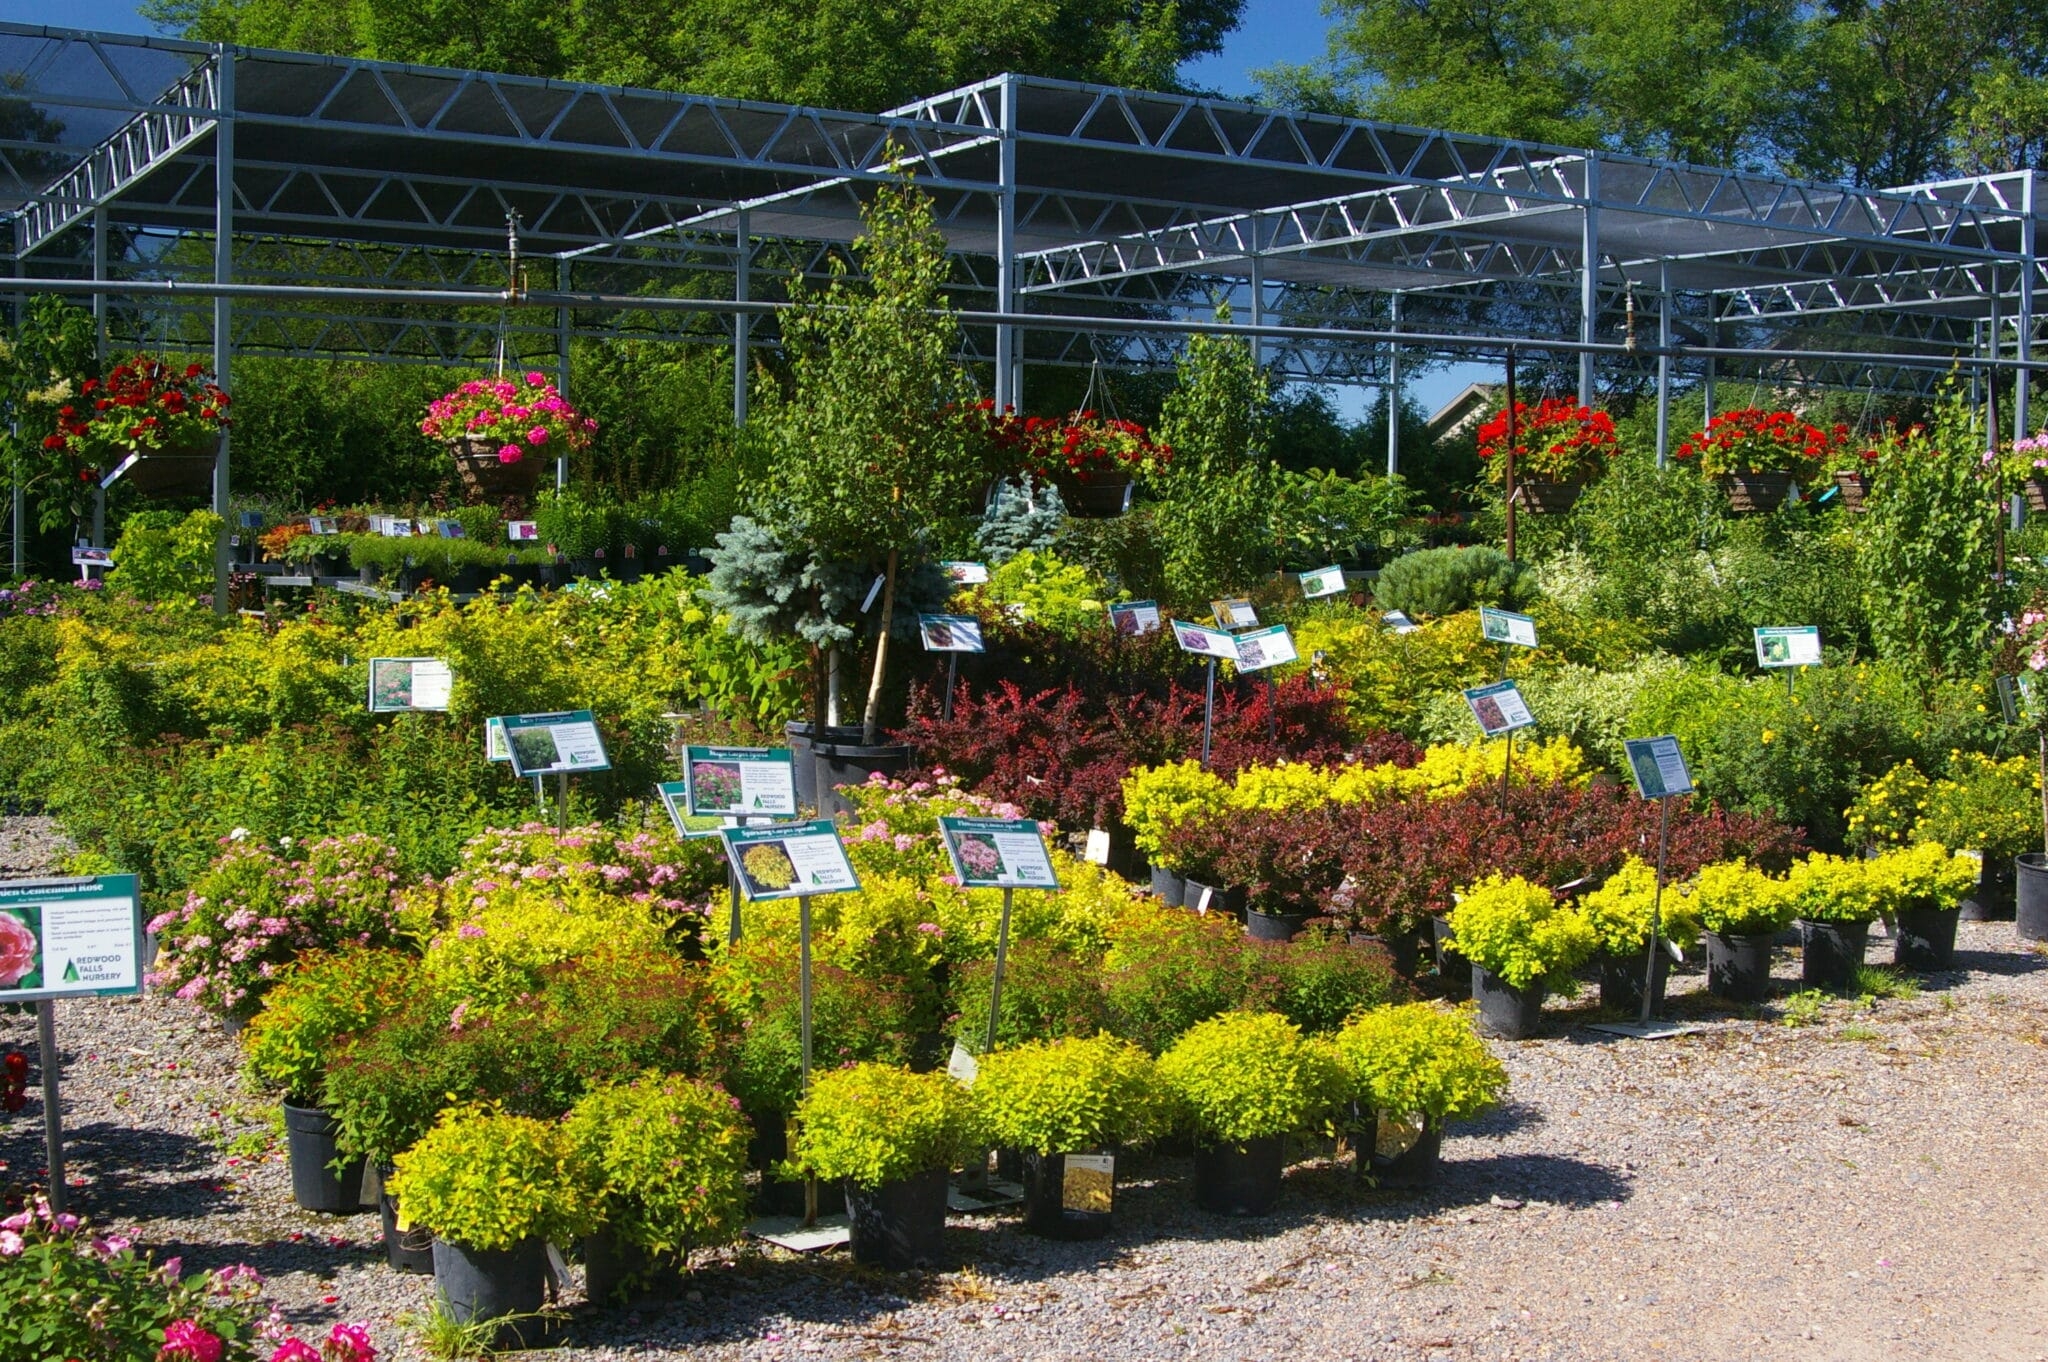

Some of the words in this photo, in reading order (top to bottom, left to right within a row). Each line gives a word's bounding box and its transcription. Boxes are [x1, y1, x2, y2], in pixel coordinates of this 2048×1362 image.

[21, 884, 77, 896] Centennial
[78, 883, 104, 892] Rose
[76, 954, 121, 964] REDWOOD
[80, 964, 103, 973] FALLS
[83, 971, 122, 981] NURSERY
